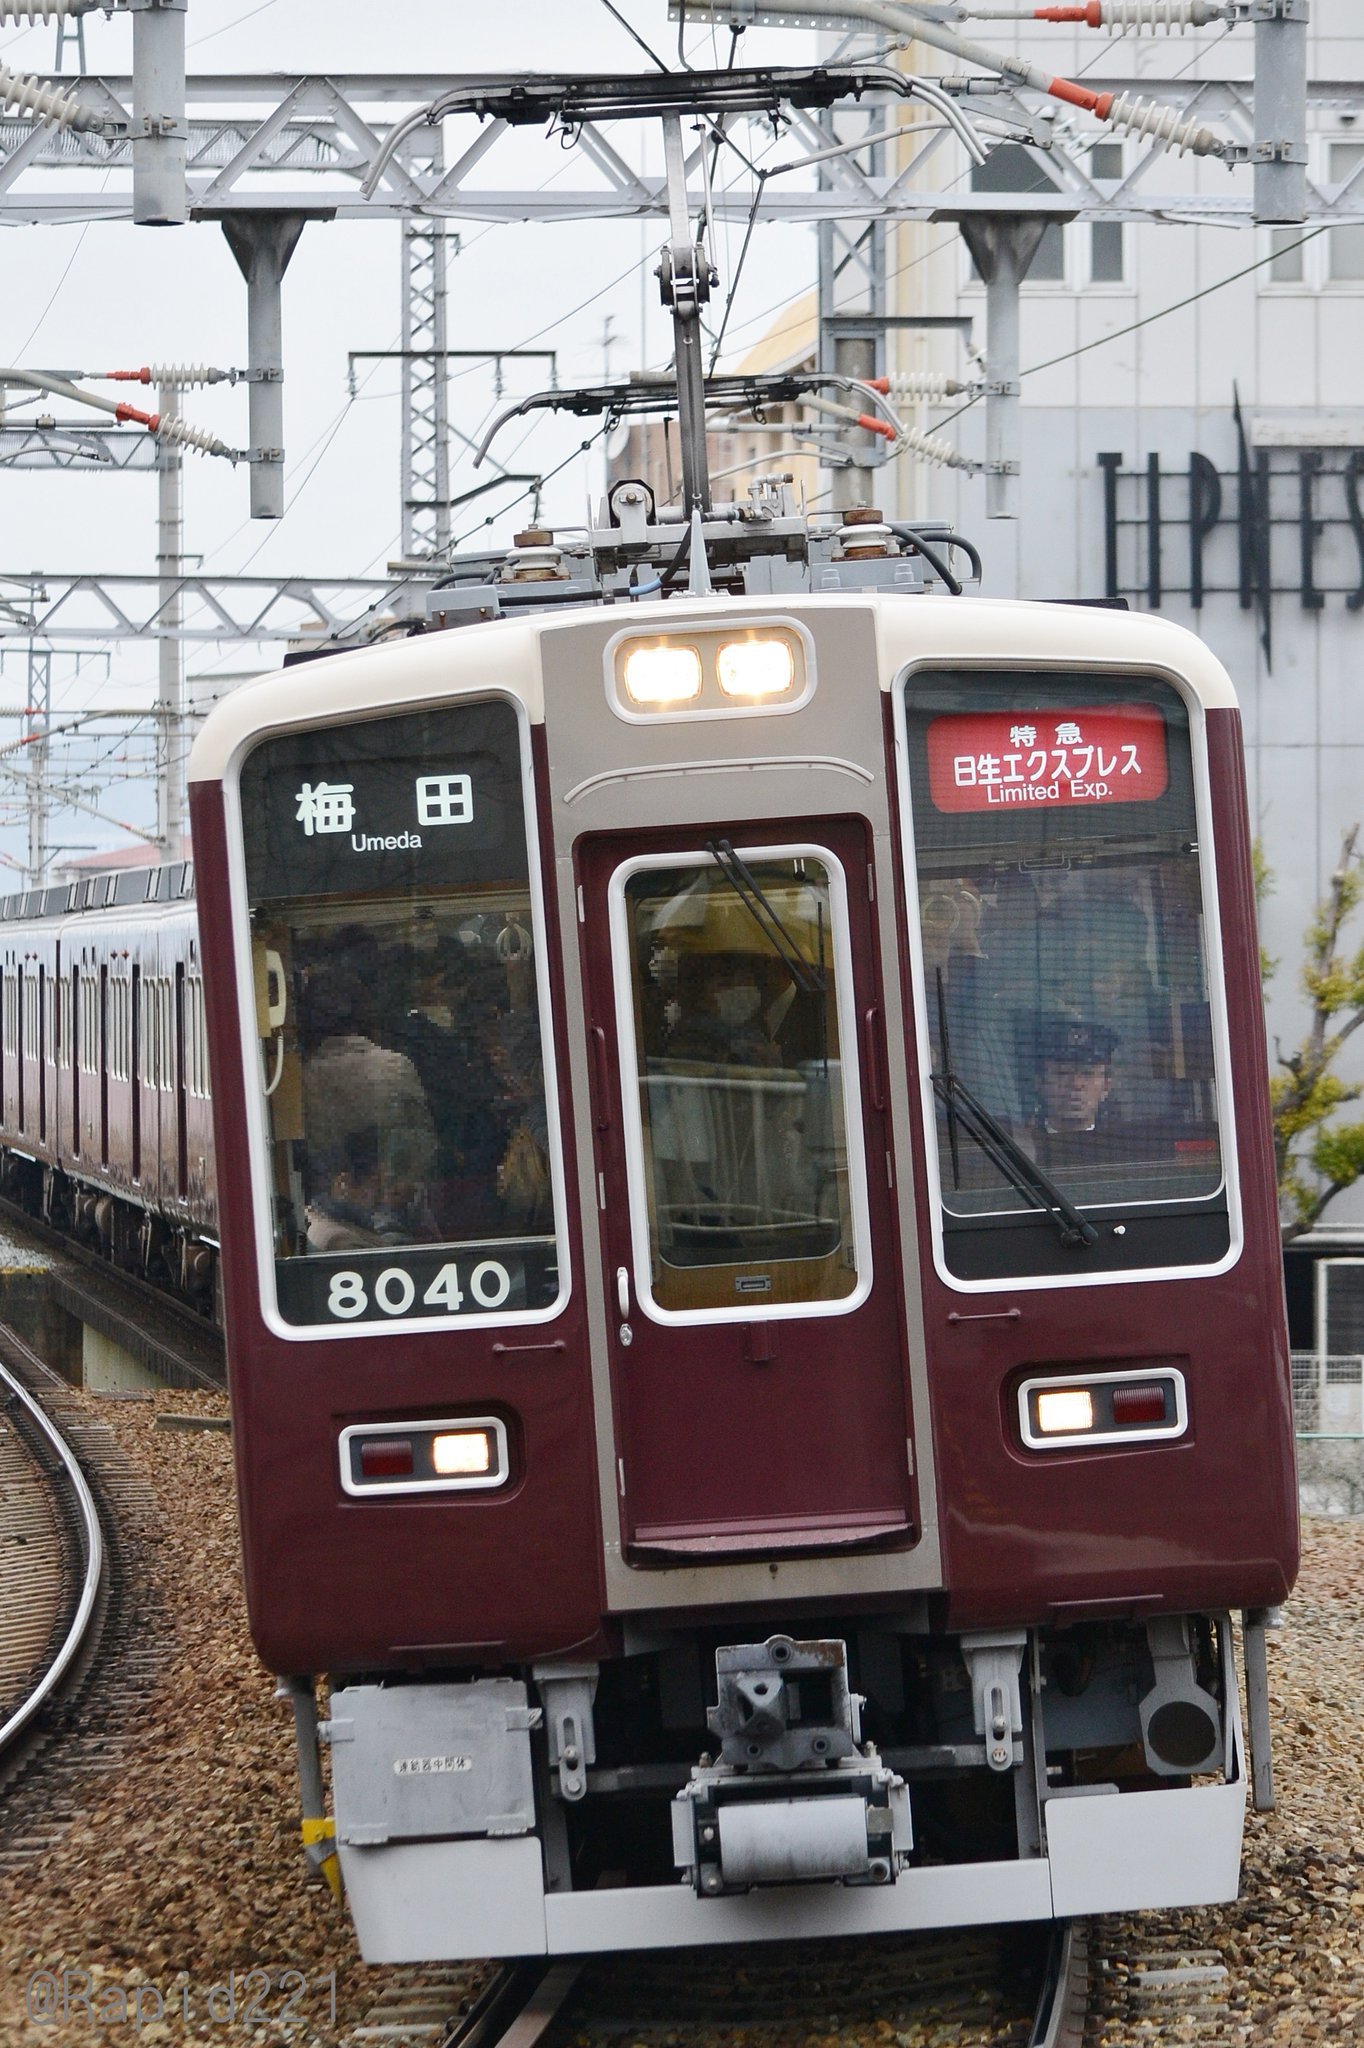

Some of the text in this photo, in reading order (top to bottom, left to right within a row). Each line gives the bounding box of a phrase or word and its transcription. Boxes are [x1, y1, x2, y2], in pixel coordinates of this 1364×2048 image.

[1009, 722, 1083, 748] 特急
[953, 745, 1142, 787] 日生エクスプレス
[295, 774, 474, 836] 梅田
[986, 779, 1113, 803] Limited Exp.
[351, 831, 422, 852] Umeda
[327, 1260, 511, 1319] 8040
